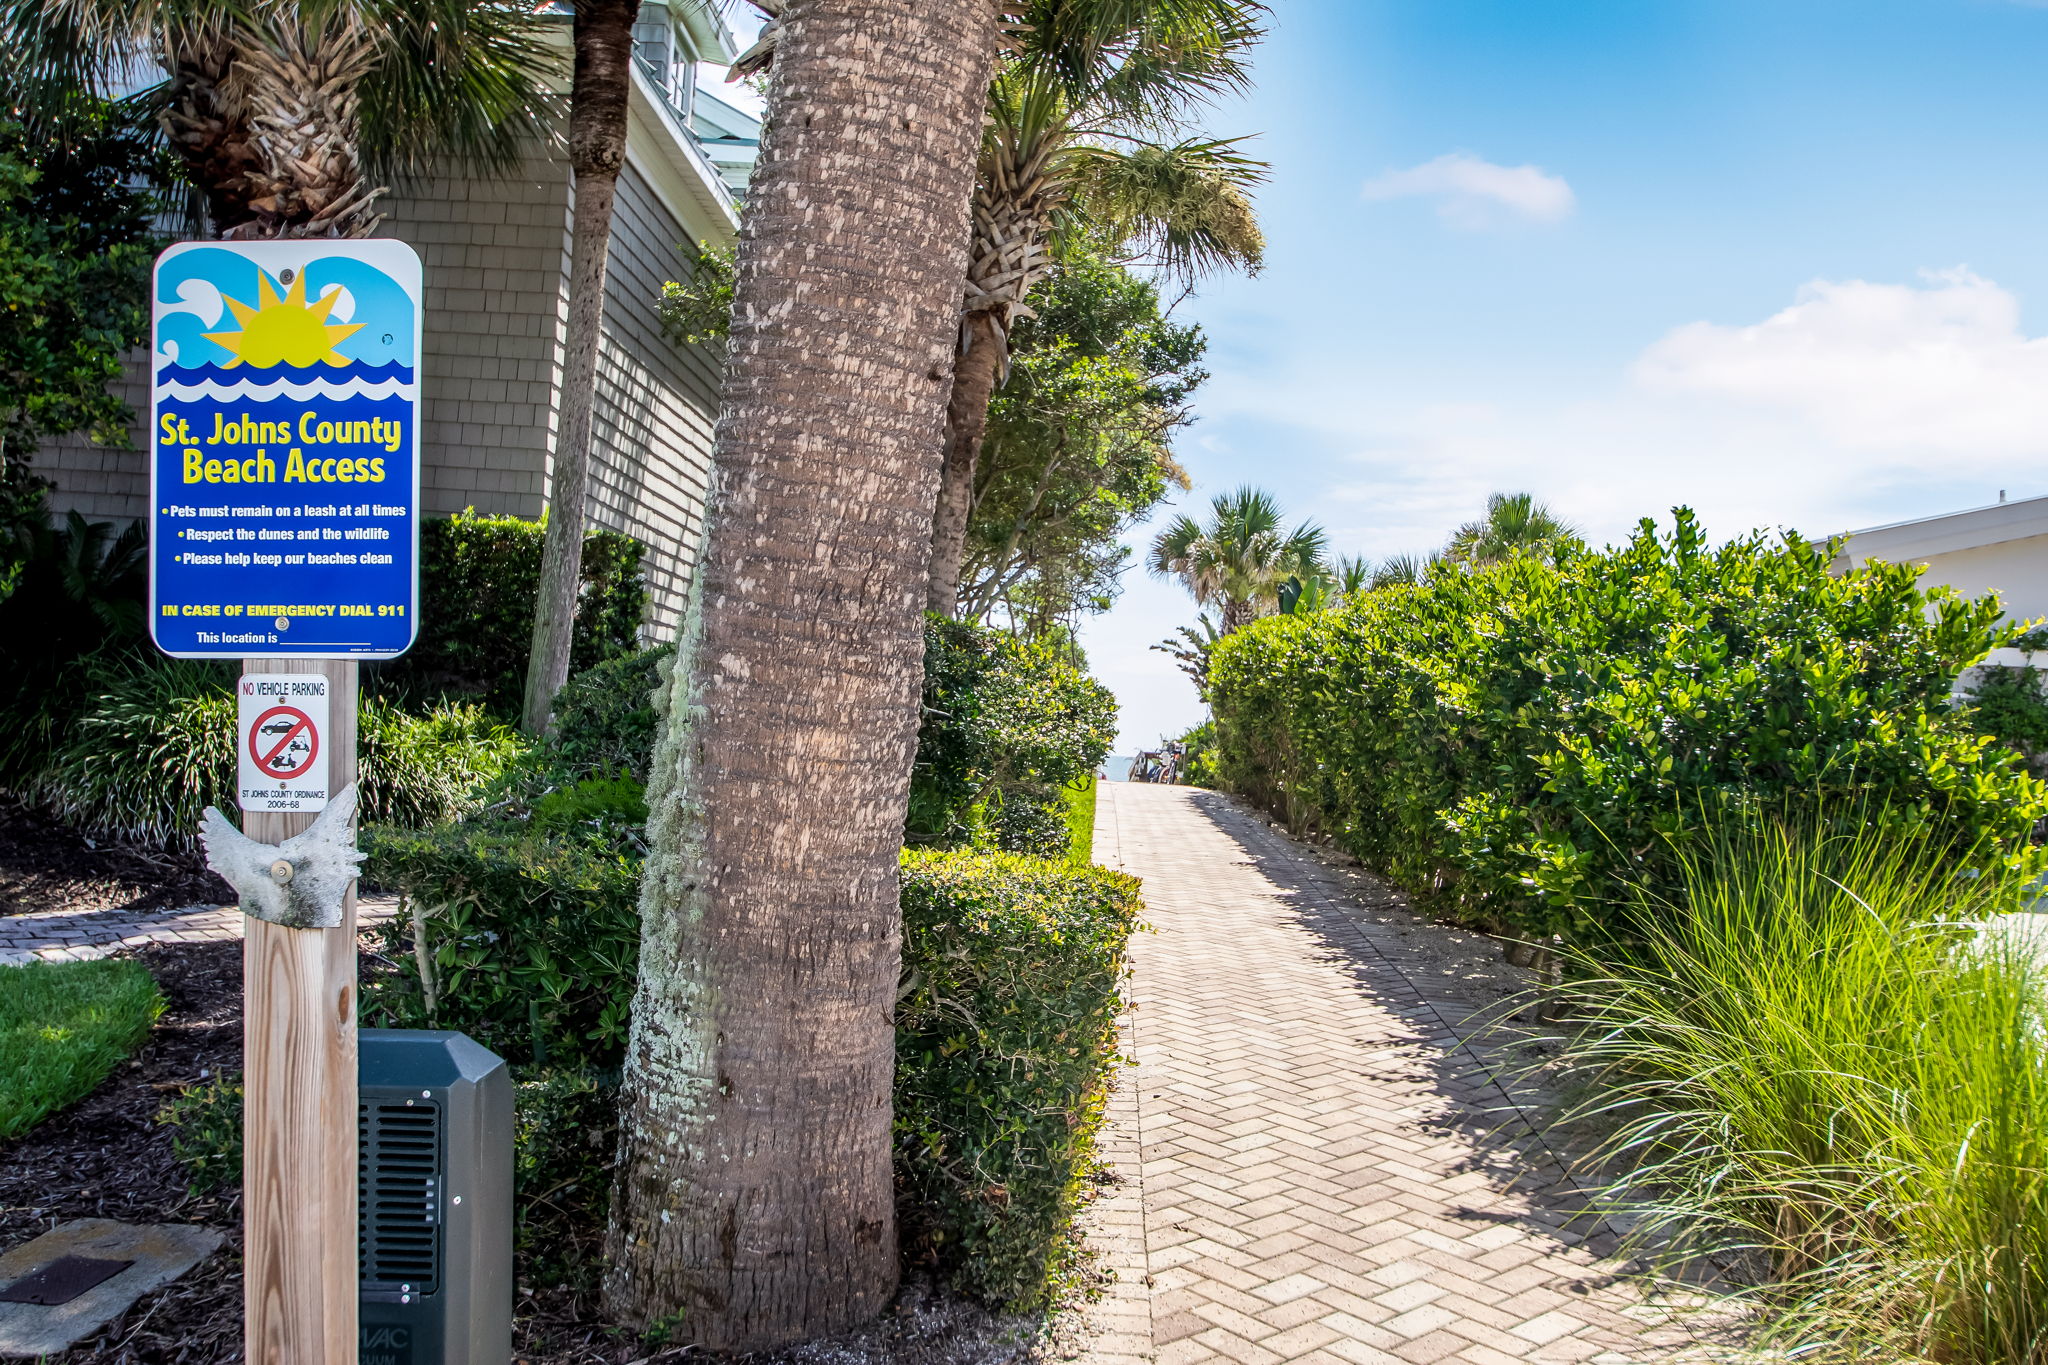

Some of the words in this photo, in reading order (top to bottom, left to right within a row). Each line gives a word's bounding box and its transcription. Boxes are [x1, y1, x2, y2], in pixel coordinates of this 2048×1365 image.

[160, 413, 200, 445] St.
[207, 413, 291, 445] Johns
[299, 411, 401, 452] County
[183, 449, 275, 483] Beach
[284, 448, 385, 483] Access
[170, 506, 196, 517] Pets
[199, 506, 229, 517] must
[232, 506, 272, 517] remain
[275, 508, 290, 516] on
[294, 508, 301, 516] a
[304, 505, 336, 516] leash
[339, 506, 351, 516] at
[354, 505, 369, 516] all
[372, 505, 406, 516] times
[186, 529, 234, 542] Respect
[236, 529, 256, 540] the
[258, 528, 294, 540] dunes
[297, 528, 319, 539] and
[322, 528, 341, 539] the
[345, 528, 389, 539] wildlife
[183, 553, 222, 564] Please
[225, 553, 250, 566] help
[253, 553, 282, 566] keep
[284, 556, 305, 564] our
[307, 553, 357, 564] beaches
[360, 553, 392, 564] clean
[162, 605, 178, 616] IN
[182, 605, 220, 616] CASE
[224, 605, 243, 616] OF
[247, 605, 336, 616] EMERGENCY
[340, 605, 374, 616] DIAL
[378, 605, 405, 616] 911
[196, 632, 219, 643] This
[222, 632, 265, 643] location
[268, 632, 278, 643] is
[243, 683, 254, 695] NO
[257, 683, 289, 695] VEHICLE
[292, 683, 325, 695] PARKING
[251, 790, 268, 798] JOHNS
[361, 1328, 408, 1350] VAC
